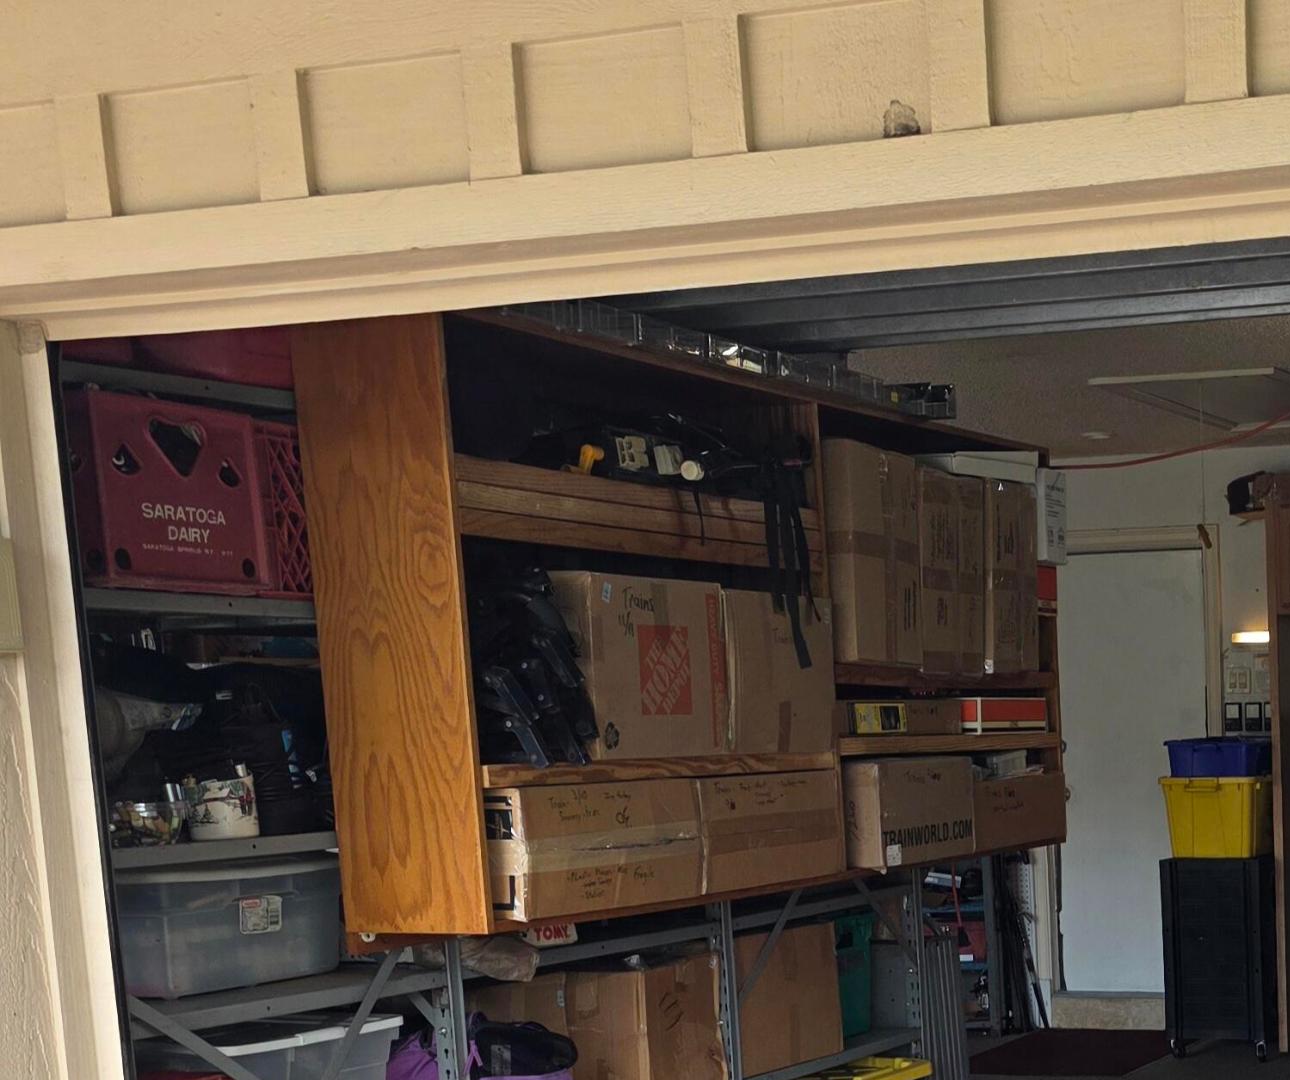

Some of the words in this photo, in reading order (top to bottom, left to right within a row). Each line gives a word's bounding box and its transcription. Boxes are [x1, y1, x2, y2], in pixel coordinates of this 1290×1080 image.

[141, 503, 226, 525] SARATOGA
[168, 526, 210, 544] DAIRY
[621, 586, 656, 613] Trains
[642, 627, 688, 714] HOME
[661, 660, 691, 714] DEPOT
[883, 819, 972, 849] TRAINWORLD.COM
[533, 925, 568, 941] TOMY
